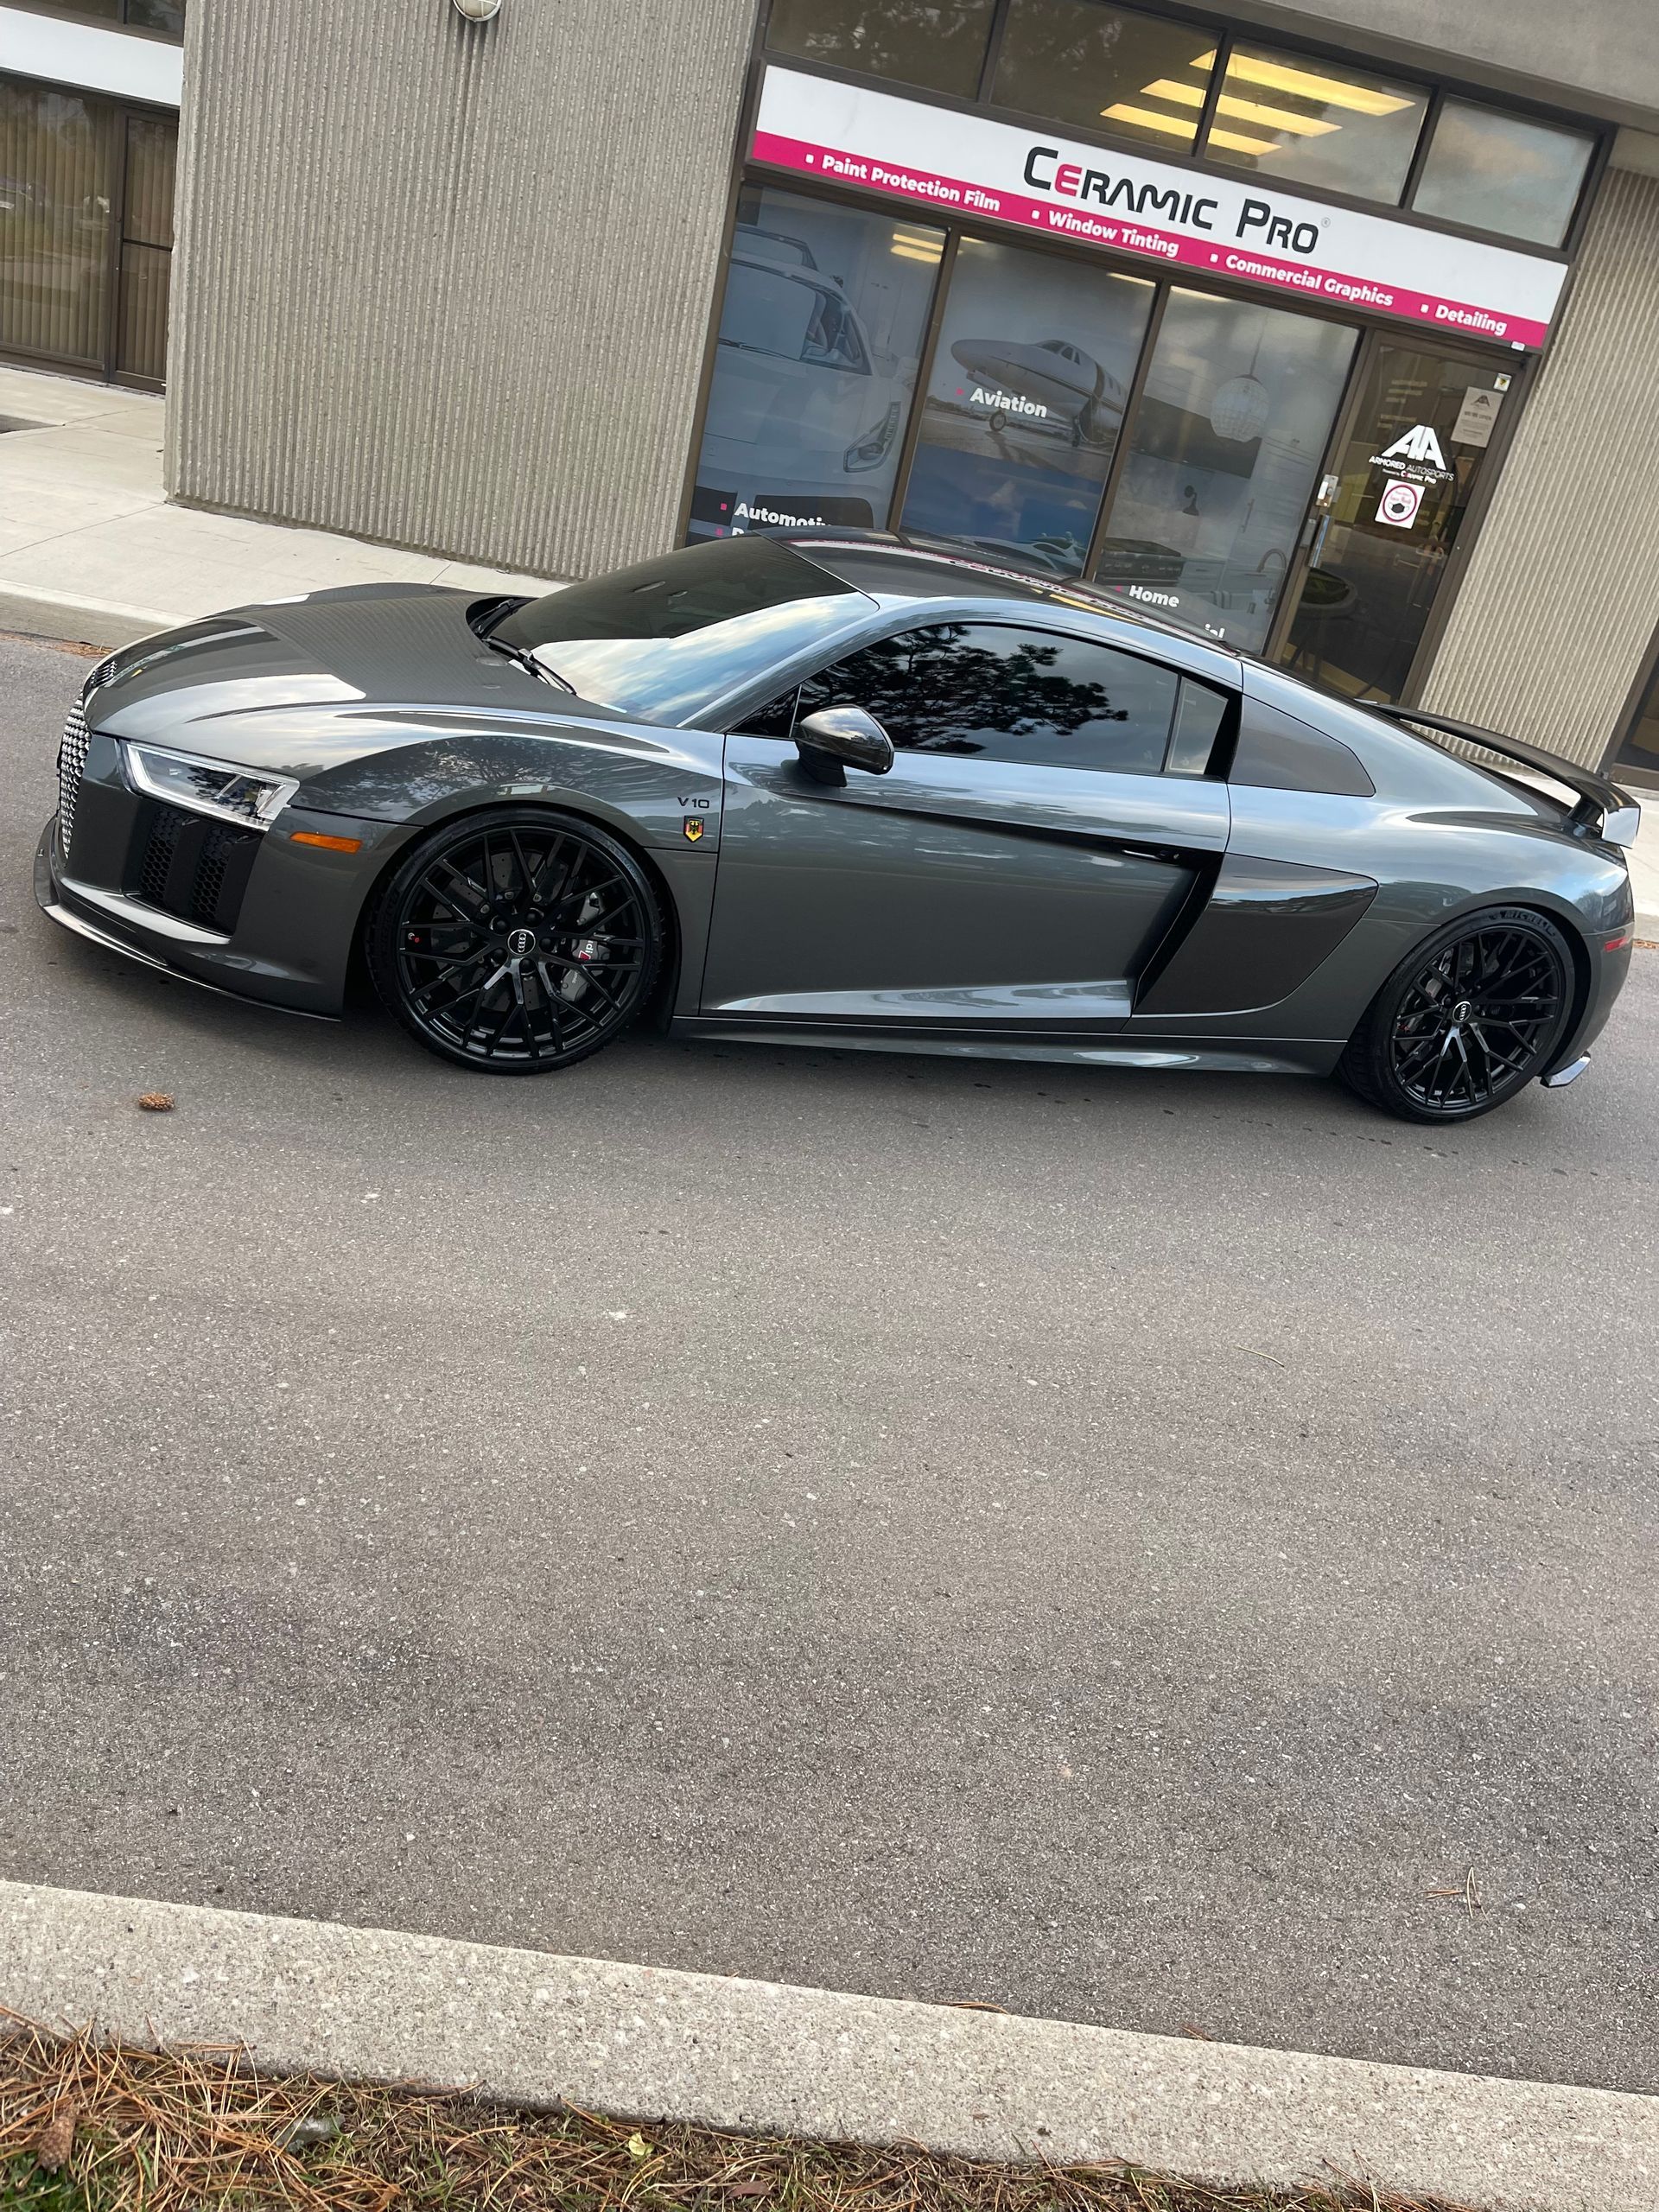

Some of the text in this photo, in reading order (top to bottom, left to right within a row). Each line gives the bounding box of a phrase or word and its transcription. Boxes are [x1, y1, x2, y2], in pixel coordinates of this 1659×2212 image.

[822, 155, 1001, 212] Paint Protection Film
[1049, 210, 1179, 258] Window Tinting
[1225, 254, 1394, 307] Commercial Graphics
[1434, 304, 1508, 337] Detailing
[969, 387, 1047, 418] Aviation
[1368, 455, 1406, 470] ARMORED
[1405, 464, 1455, 481] AUTOSPORTS
[734, 502, 831, 526] Automoti
[1128, 585, 1180, 607] Home
[677, 796, 709, 809] V10
